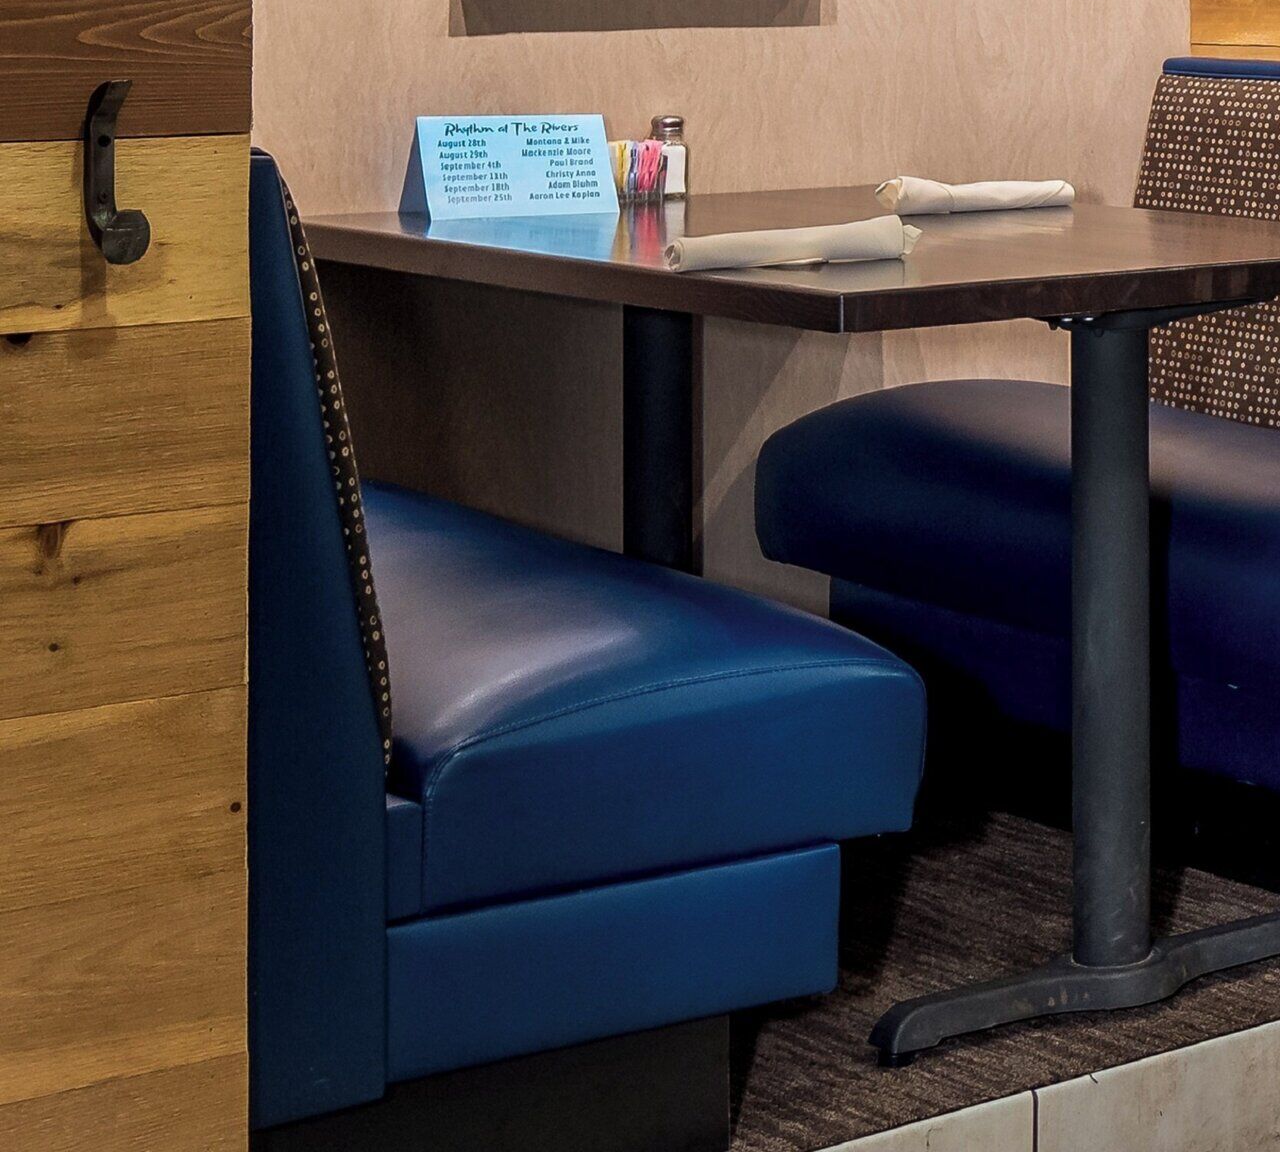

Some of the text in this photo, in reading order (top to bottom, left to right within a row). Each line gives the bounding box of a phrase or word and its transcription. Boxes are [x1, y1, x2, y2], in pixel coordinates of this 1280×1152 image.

[444, 121, 579, 137] Rhythm at The Rivers
[437, 138, 487, 149] August 28th
[526, 136, 590, 146] Montana & Mike
[439, 149, 488, 161] August 29th
[521, 147, 591, 157] Mackenzie Moore
[440, 160, 502, 172] September 4th
[549, 158, 594, 167] Paul Brand
[442, 172, 508, 182] September 11th
[545, 169, 597, 179] Christy Anna
[444, 182, 510, 194] September 18th
[548, 181, 571, 189] Adam
[447, 193, 513, 205] September 25th
[529, 190, 601, 200] Aaron Lee Kaplan
